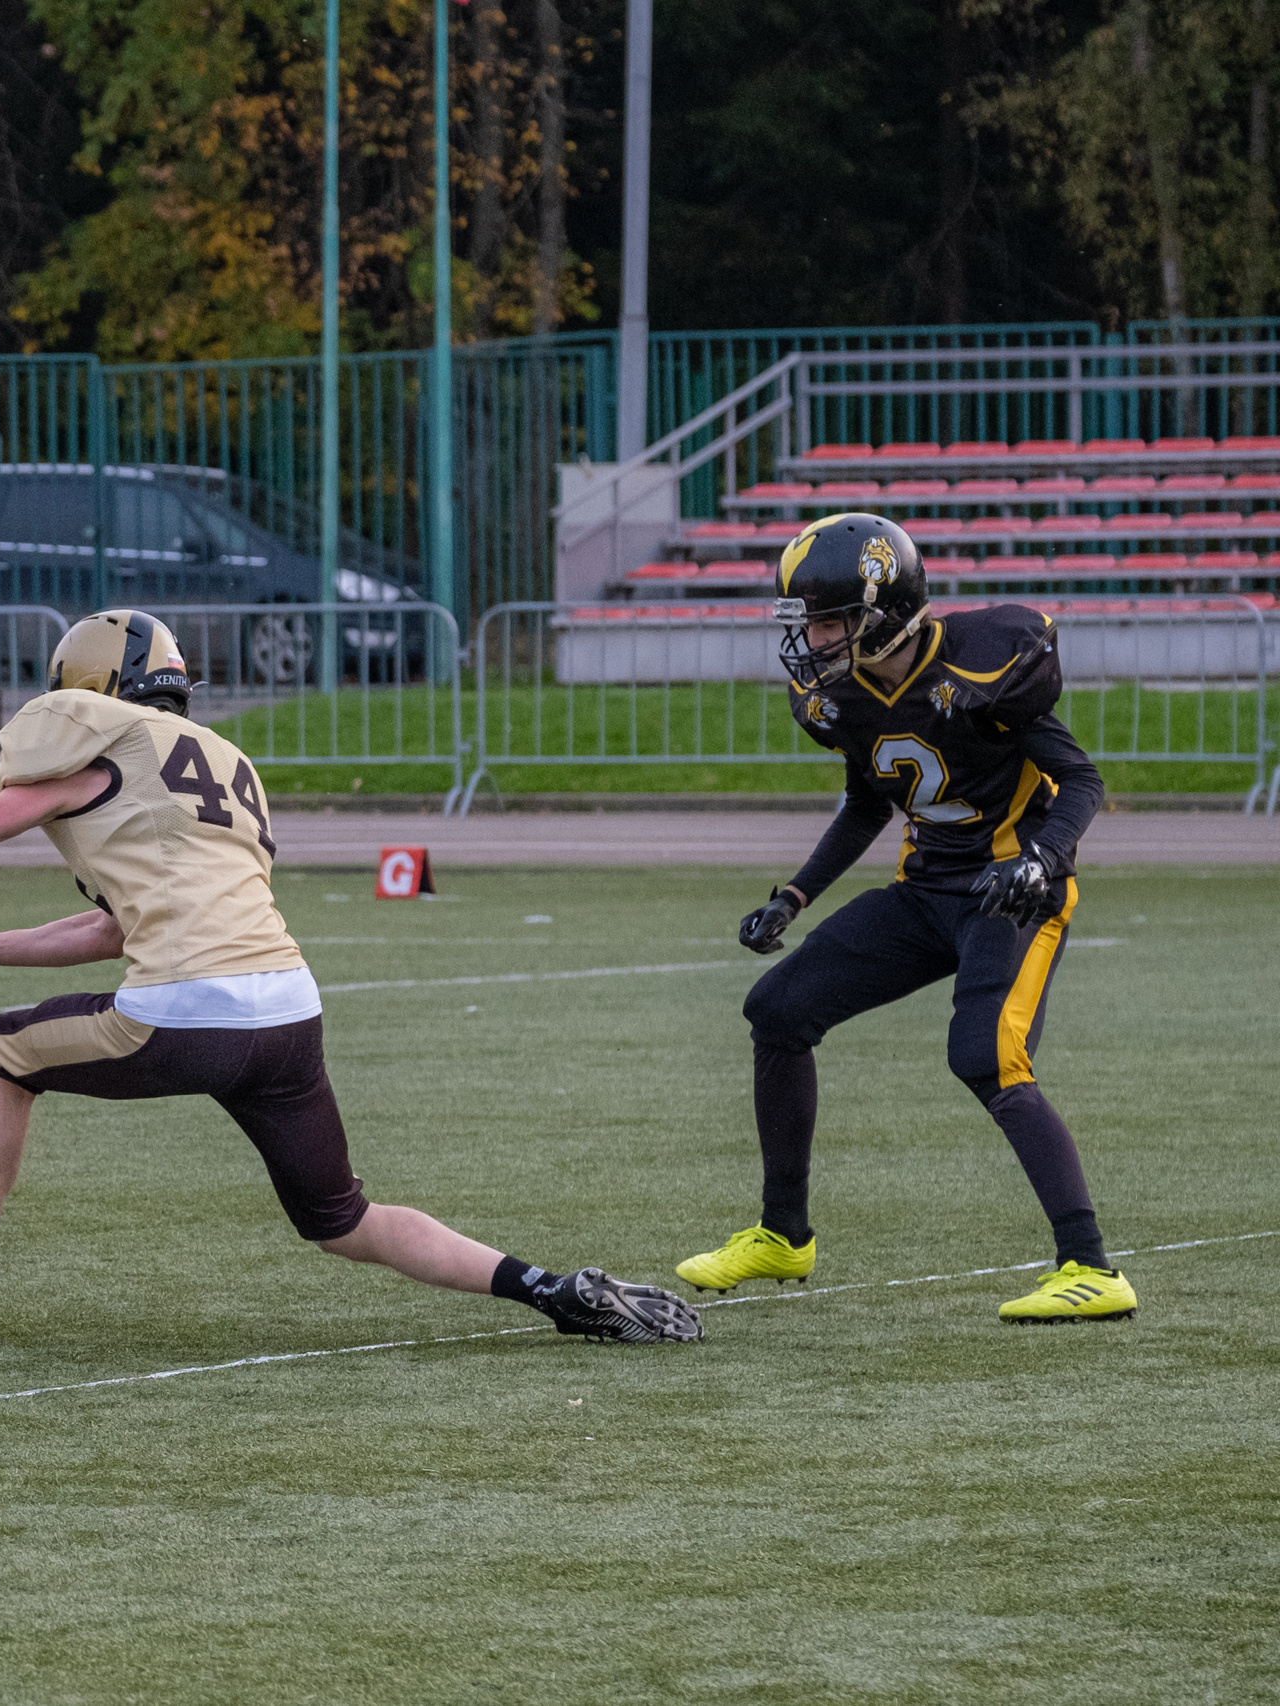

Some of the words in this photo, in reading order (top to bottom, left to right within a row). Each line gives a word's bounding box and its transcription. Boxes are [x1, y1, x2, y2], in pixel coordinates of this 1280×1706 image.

[153, 674, 188, 687] XENITH
[160, 733, 277, 861] 44
[872, 733, 982, 825] 2
[382, 851, 415, 896] G
